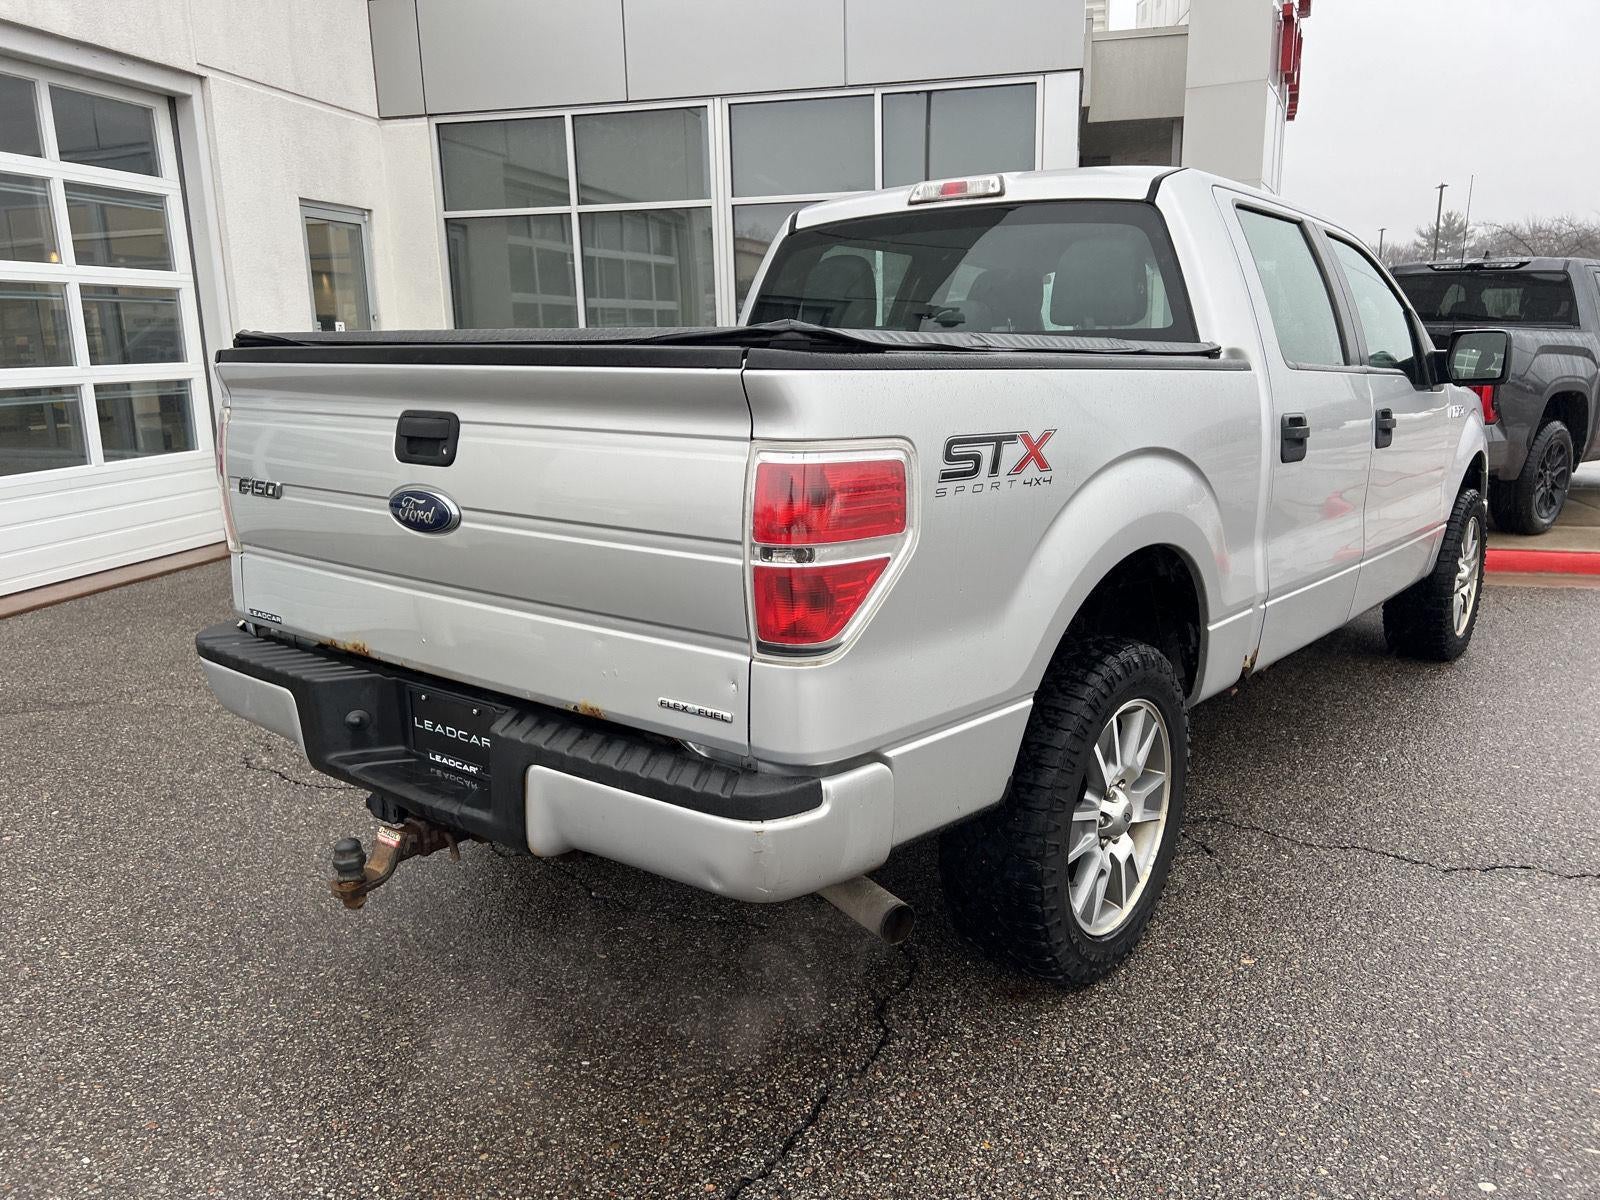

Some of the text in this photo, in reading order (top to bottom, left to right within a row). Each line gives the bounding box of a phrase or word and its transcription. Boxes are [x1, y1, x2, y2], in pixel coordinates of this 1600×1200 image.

[938, 429, 1057, 483] STX
[935, 481, 1016, 498] SPORT
[399, 495, 435, 525] Ford
[249, 609, 281, 623] LEADCAR
[660, 699, 728, 722] FLEX FUEL
[429, 753, 478, 774] LEADCAR
